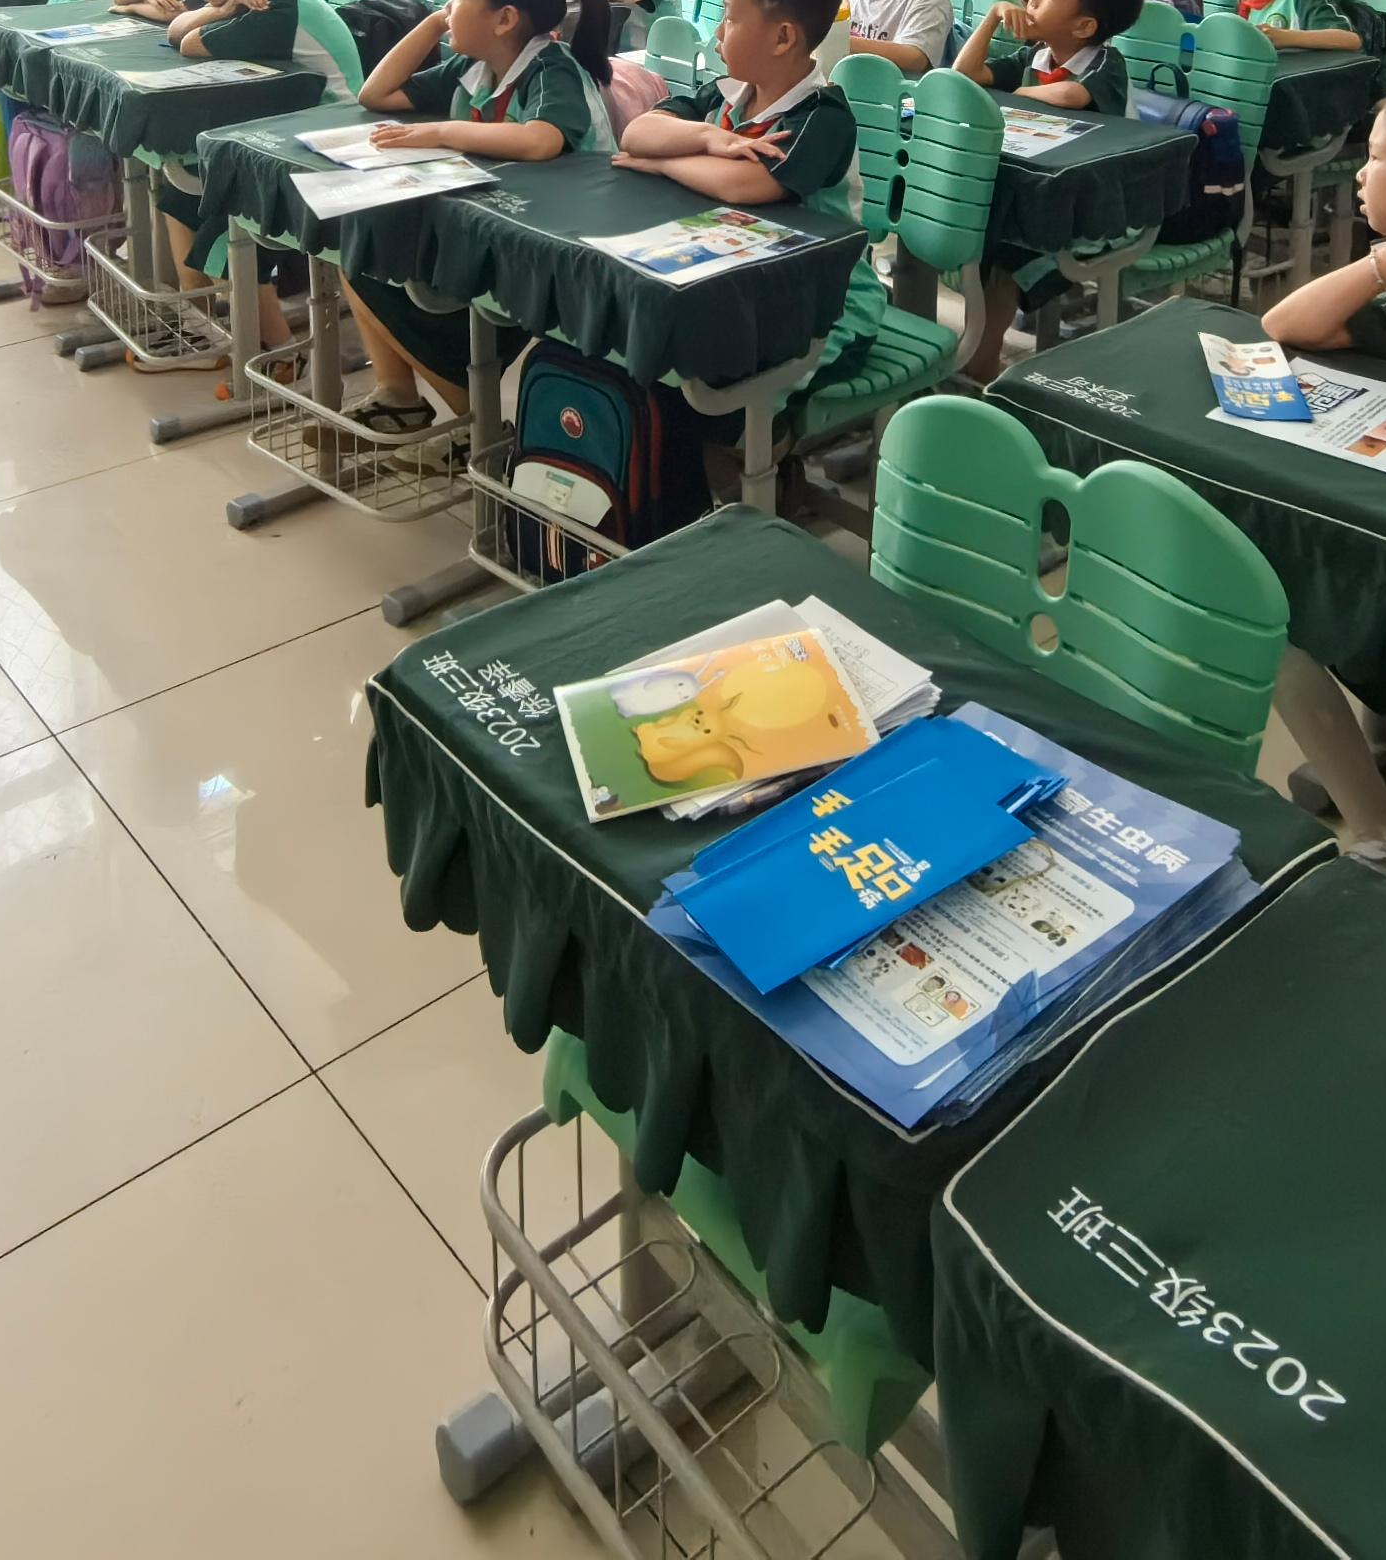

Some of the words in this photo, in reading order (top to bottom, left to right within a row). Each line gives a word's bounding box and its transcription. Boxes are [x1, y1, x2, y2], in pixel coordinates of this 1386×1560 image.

[1023, 372, 1141, 418] 2023级三班
[422, 650, 540, 756] 2023级三班
[478, 659, 555, 718] 徐睿泽
[809, 826, 912, 909] 手足口病
[1054, 787, 1190, 873] 寄生虫病
[1047, 1186, 1346, 1421] 2023级三班
